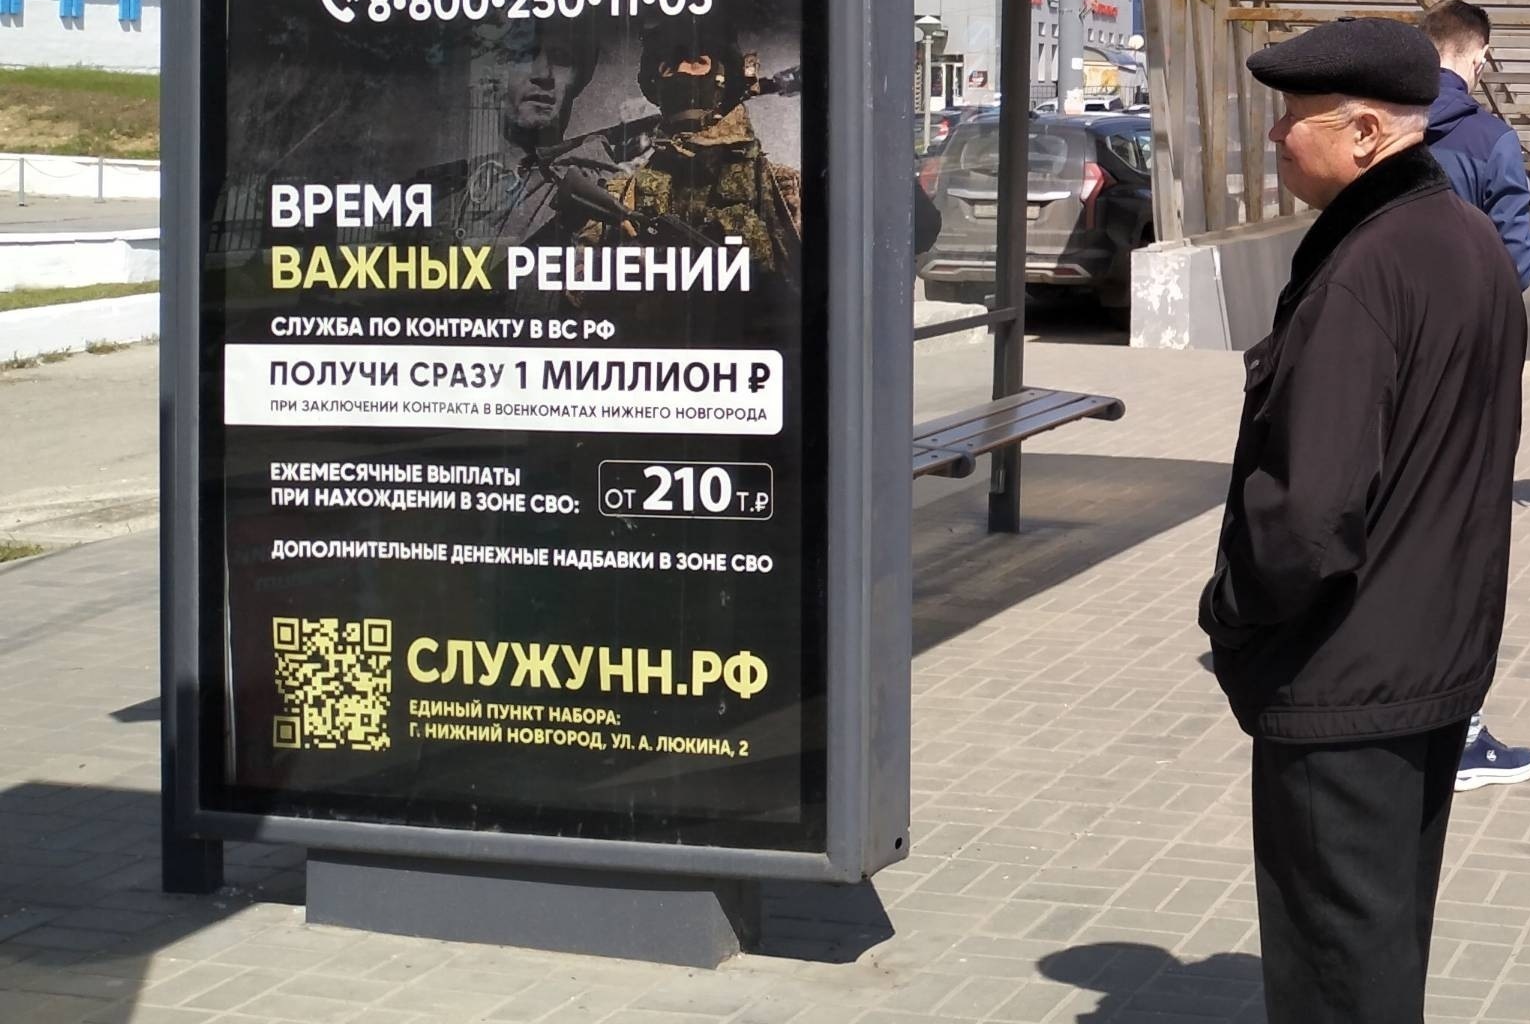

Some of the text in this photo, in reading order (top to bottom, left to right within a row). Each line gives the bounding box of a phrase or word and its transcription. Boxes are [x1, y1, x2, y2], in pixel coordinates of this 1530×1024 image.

[271, 183, 433, 228] ВРЕМЯ
[271, 235, 752, 292] ВАЖНЫХ РЕШЕНИЙ
[270, 315, 616, 341] СЛУЖБА ПО КОНТРАКТУ В ВС РФ
[270, 360, 398, 387] ПОЛУЧИ
[409, 361, 505, 390] СРАЗУ
[515, 361, 528, 391] 1
[542, 359, 737, 394] МИЛЛИОН
[270, 399, 768, 423] ПРИ ЗАКЛЮЧЕНИИ КОНТРАКТА В ВОЕНКОМАТАХ НИЖНЕГО НОВГОРОДА
[270, 461, 521, 487] ЕЖЕМЕСЯЧНЫЕ ВЫПЛАТЫ
[605, 488, 637, 510] ОТ
[642, 465, 732, 513] 210
[271, 486, 580, 515] ПРИ НАХОЖДЕНИИ В ЗОНЕ СВО:
[270, 539, 774, 574] ДОПОЛНИТЕЛЬНЫЕ ДЕНЕЖНЫЕ НАДБАВКИ В ЗОНЕ СВО
[406, 636, 769, 700] СЛУЖУНН.РФ
[409, 698, 621, 726] ЕДИНЫЙ ПУНКТ НАБОРА:
[424, 721, 503, 743] НИЖНИЙ
[506, 726, 607, 752] НОВГОРОД,
[610, 731, 636, 751] УЛ.
[655, 735, 736, 758] ЛЮКИНА,
[738, 739, 749, 758] 2
